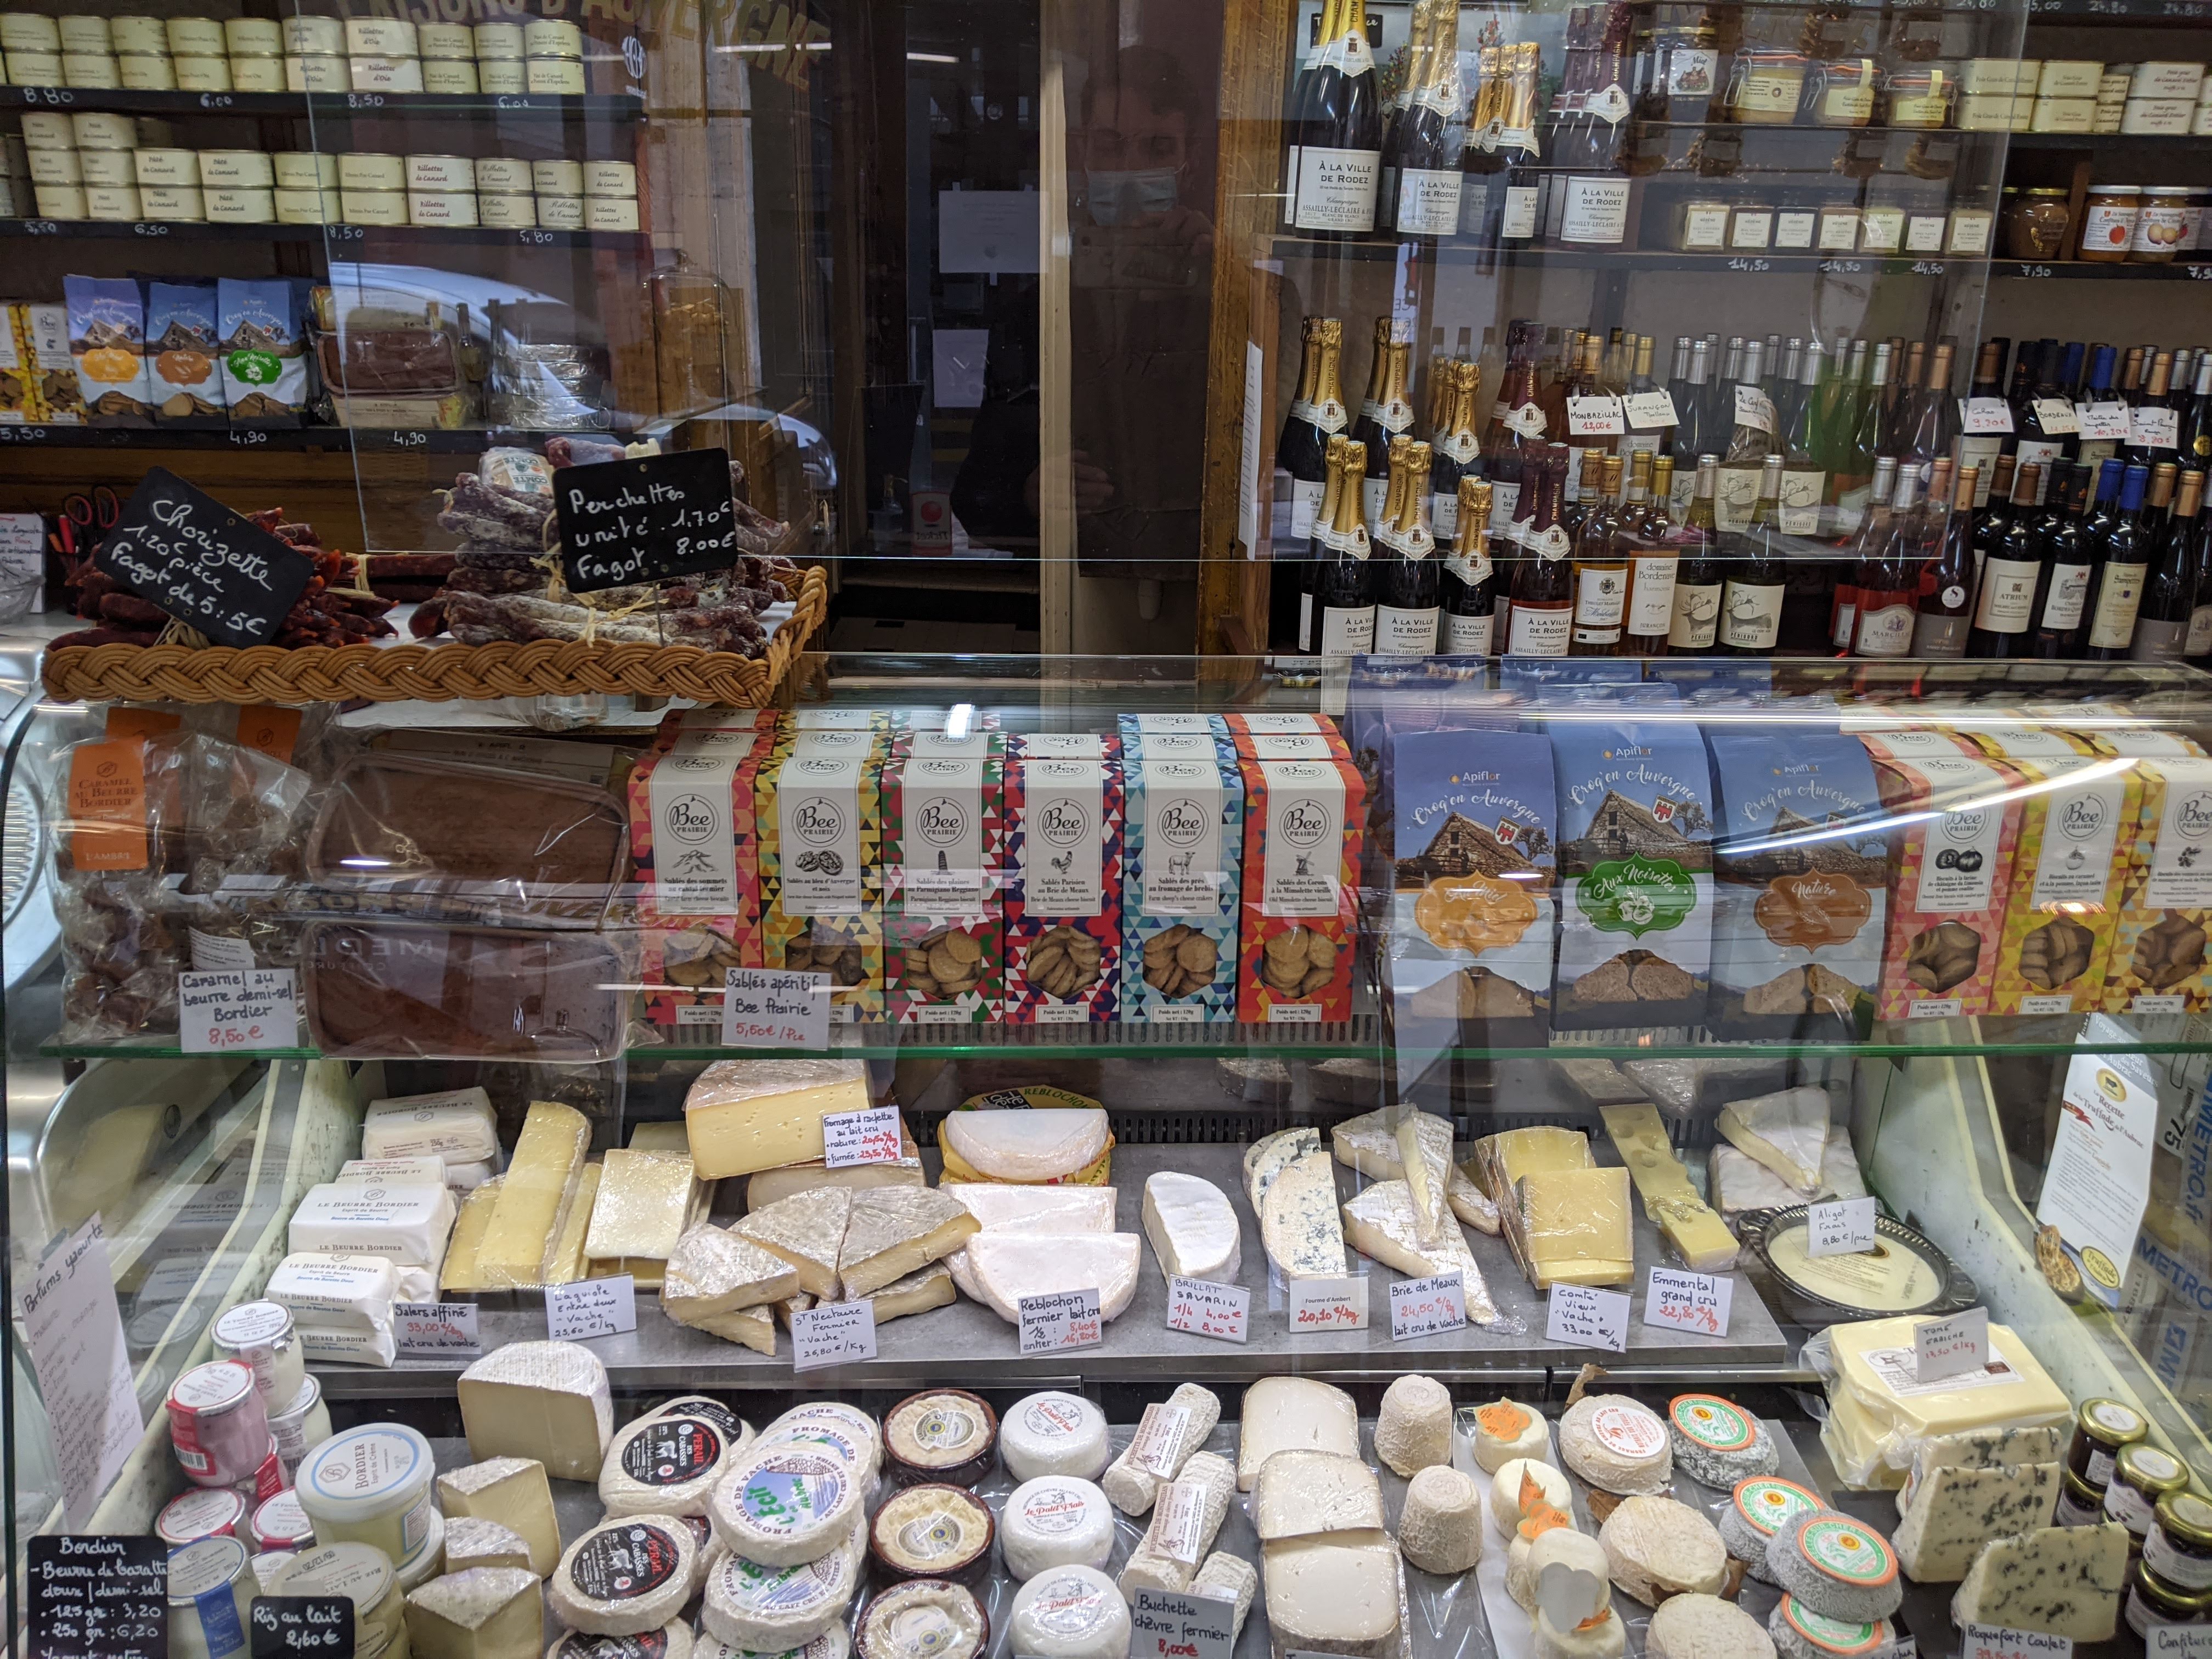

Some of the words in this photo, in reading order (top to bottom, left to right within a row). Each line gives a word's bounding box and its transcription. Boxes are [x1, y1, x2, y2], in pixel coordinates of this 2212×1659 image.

[1319, 161, 1325, 171] À
[1347, 163, 1372, 172] VILLE
[1338, 175, 1369, 184] RODEZ
[428, 210, 450, 218] Canard
[134, 224, 168, 235] 6,50
[1571, 411, 1622, 420] MONBAZILLAC
[230, 431, 267, 444] 4,90
[393, 431, 426, 444] 4,90
[1414, 481, 1423, 520] CHAMPAGNE
[111, 542, 172, 584] Fagot
[1616, 746, 1652, 759] Apiflor
[1462, 771, 1500, 783] Apiflor
[669, 804, 711, 828] Bee
[1043, 808, 1084, 830] Bee
[2064, 800, 2100, 823] Bee
[1284, 809, 1323, 832] Bee
[213, 1005, 273, 1022] Bordier
[736, 998, 760, 1014] Bee
[766, 997, 811, 1016] Prairie
[1819, 1208, 1846, 1224] Aligot
[1175, 1278, 1221, 1294] BRILLAT
[1392, 1285, 1413, 1297] Brie
[1415, 1283, 1429, 1294] de
[1431, 1278, 1460, 1290] Meaux
[1652, 1272, 1715, 1294] Emmental
[554, 1288, 609, 1302] Laguiole
[1021, 1295, 1084, 1311] Reblochon
[1177, 1291, 1237, 1308] SAVARIN
[1661, 1290, 1692, 1305] grand
[1700, 1296, 1717, 1306] cru
[395, 1305, 428, 1317] Salers
[811, 1308, 863, 1324] Nectaire
[1022, 1311, 1063, 1327] fermier
[1070, 1308, 1085, 1319] lait
[1394, 1324, 1408, 1336] lait
[354, 1442, 368, 1491] BORDIER
[59, 1537, 126, 1555] Bordier
[1137, 1594, 1198, 1616] Buchette
[1182, 1621, 1229, 1641] fermier
[1967, 1624, 2022, 1643] Roquefort
[2027, 1631, 2066, 1649] Coulet
